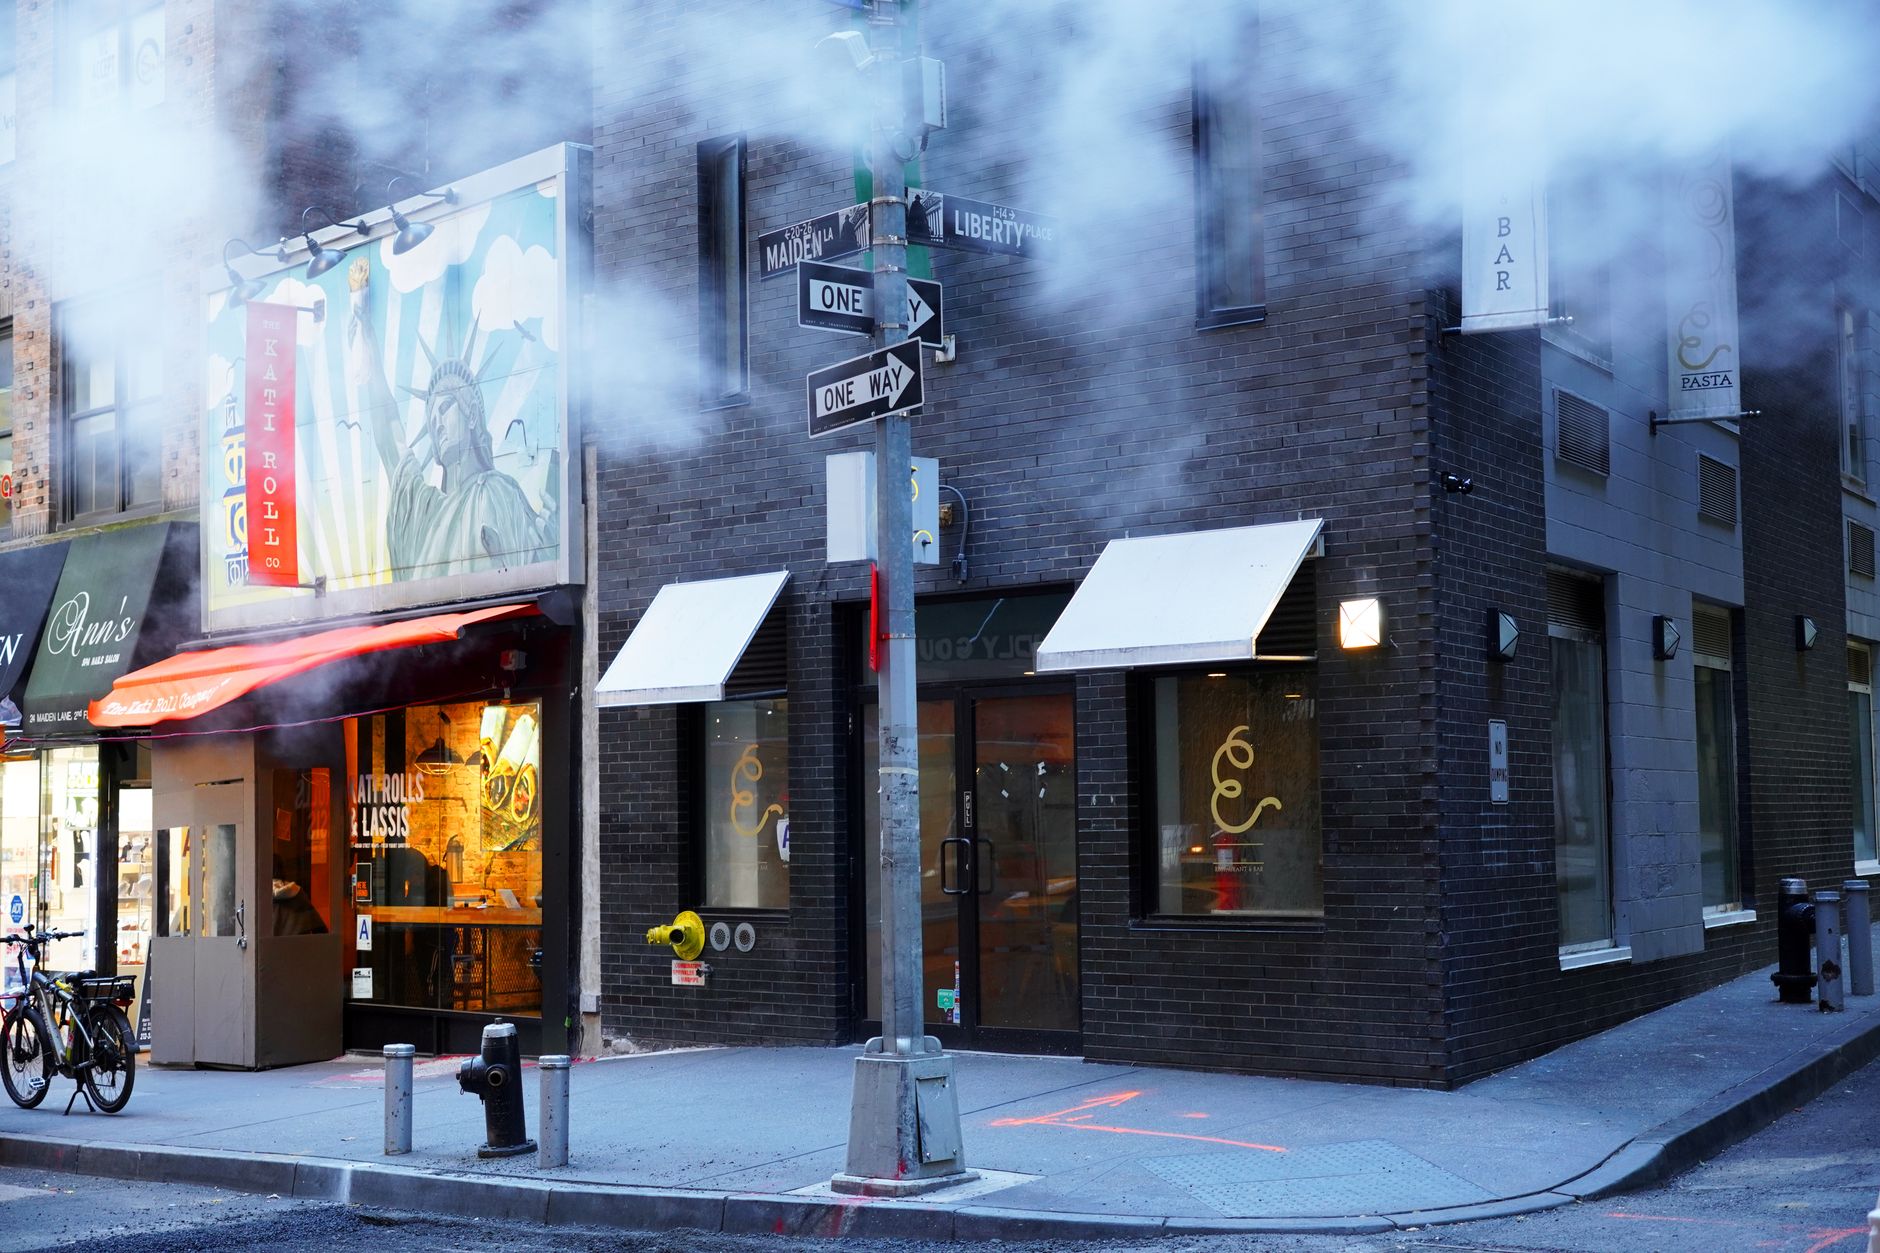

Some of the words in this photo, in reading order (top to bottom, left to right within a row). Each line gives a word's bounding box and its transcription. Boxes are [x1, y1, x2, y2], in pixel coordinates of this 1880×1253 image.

[954, 209, 1025, 247] LIBERTY
[1026, 223, 1053, 241] PLACE
[993, 206, 1007, 219] 1-14
[790, 222, 813, 239] 20-26
[766, 229, 822, 271] MAIDEN
[824, 227, 834, 242] LA
[1494, 216, 1514, 291] BAR
[821, 284, 863, 313] ONE
[262, 319, 281, 330] THE
[264, 339, 279, 432] KATI
[824, 380, 855, 412] ONE
[869, 364, 903, 398] WAY
[1682, 374, 1733, 390] PASTA
[263, 452, 279, 546] ROLL
[47, 591, 136, 657] Ann's
[81, 657, 91, 667] SPA
[91, 655, 104, 666] NAILS
[104, 653, 120, 664] SALON
[29, 713, 36, 723] 24
[36, 712, 56, 723] MAIDEN
[73, 709, 83, 720] 2nd
[382, 772, 425, 804] ROLLS
[351, 807, 358, 837] &
[362, 805, 410, 837] LASSIS
[359, 919, 369, 940] A
